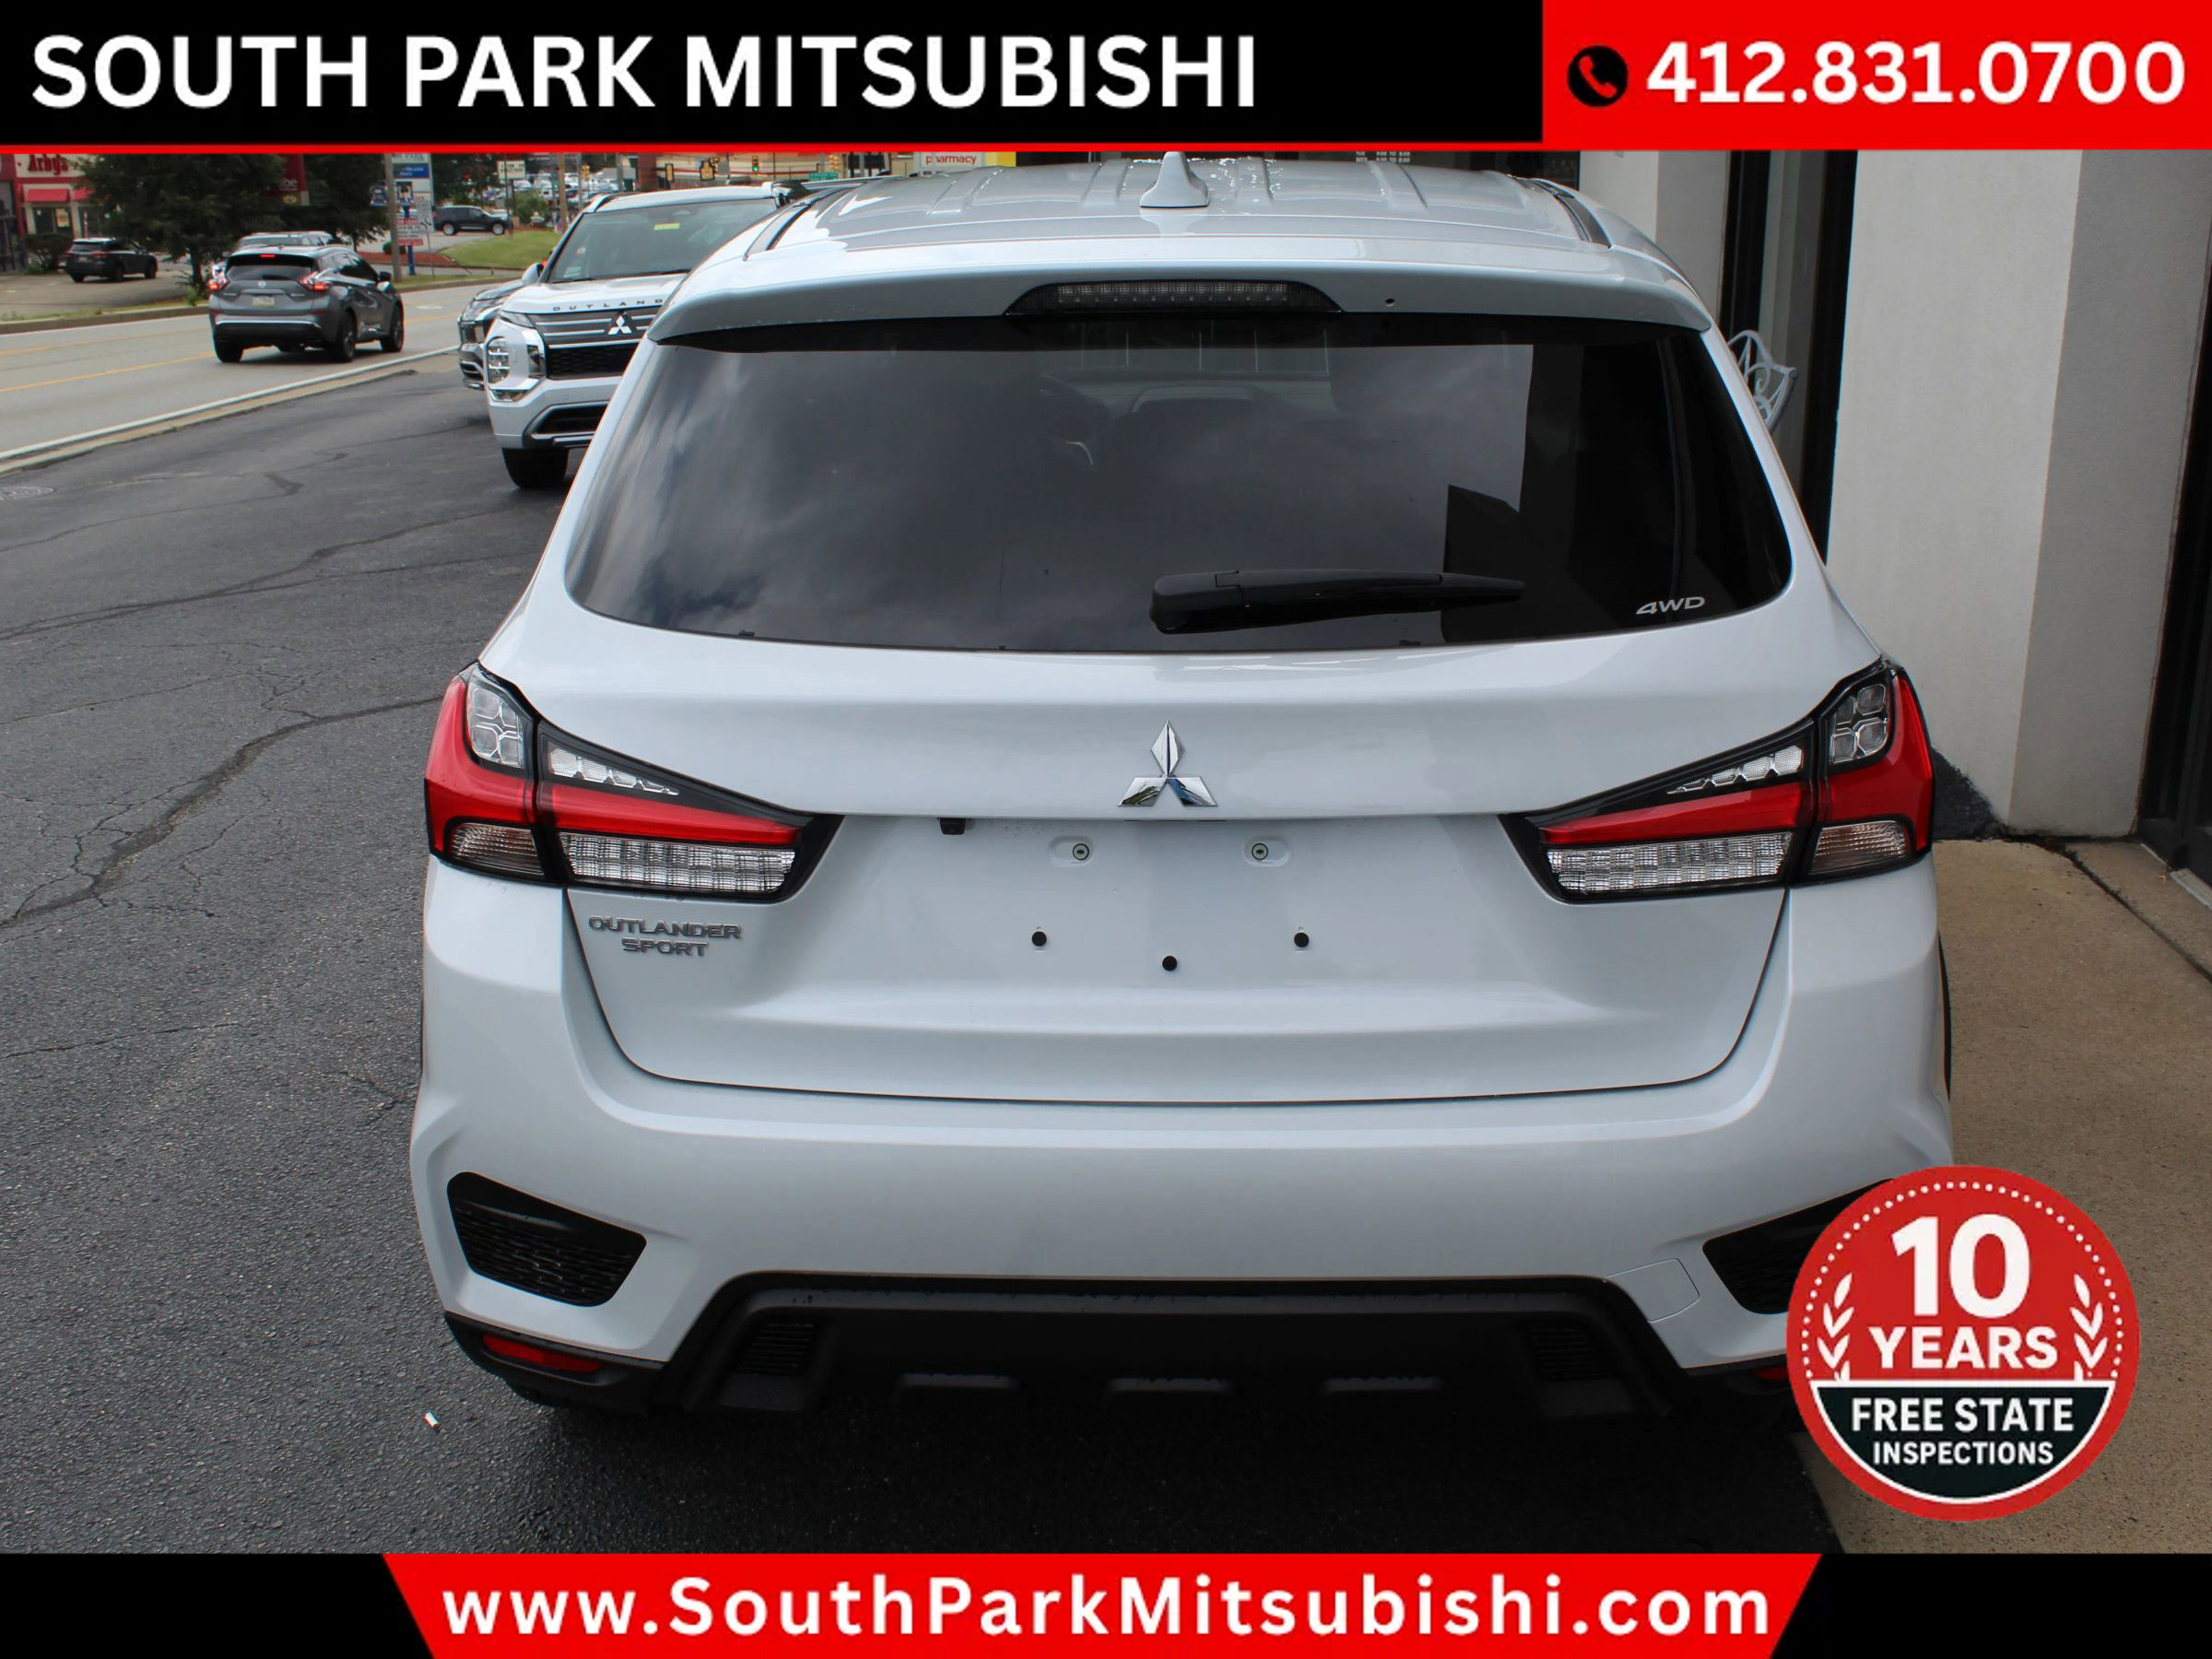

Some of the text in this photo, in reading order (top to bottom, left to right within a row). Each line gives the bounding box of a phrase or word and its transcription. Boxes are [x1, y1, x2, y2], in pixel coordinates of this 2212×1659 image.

[552, 299, 663, 312] OUTLAND
[1636, 596, 1705, 615] 4WD
[589, 915, 742, 939] OUTLANDER
[622, 936, 709, 957] SPORT
